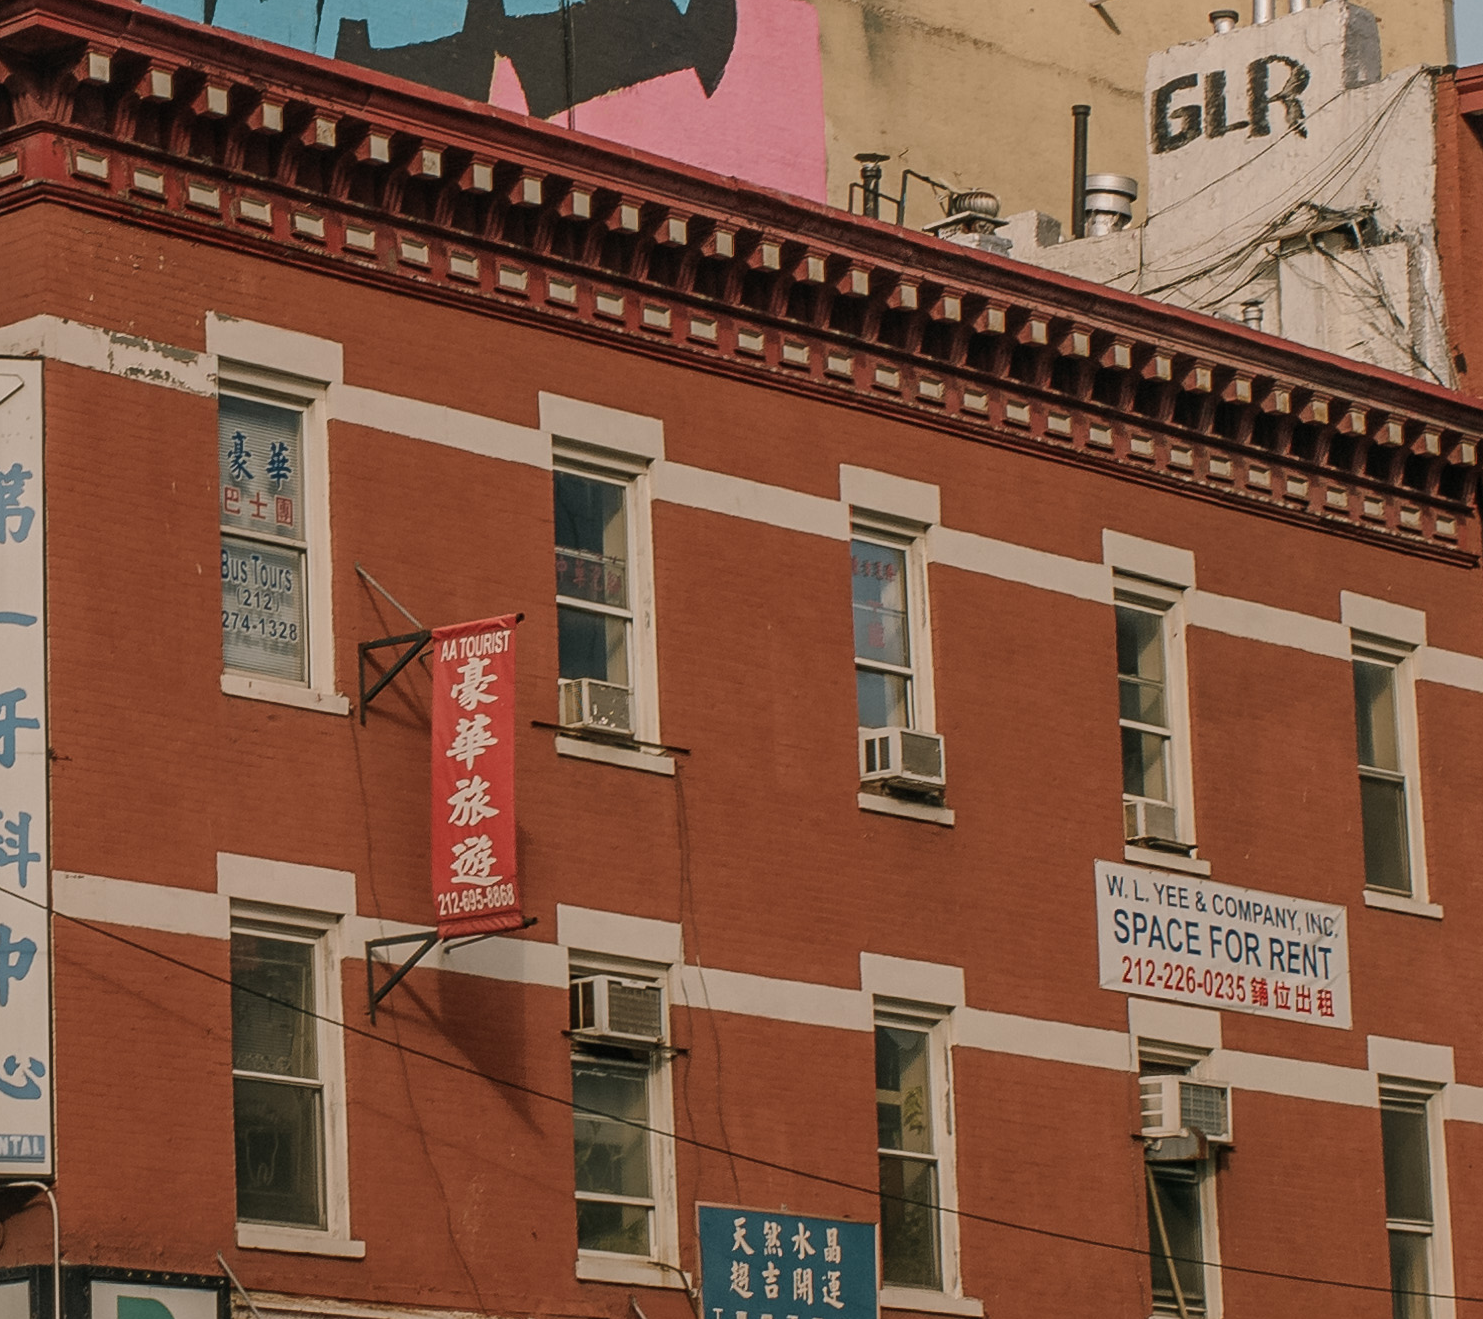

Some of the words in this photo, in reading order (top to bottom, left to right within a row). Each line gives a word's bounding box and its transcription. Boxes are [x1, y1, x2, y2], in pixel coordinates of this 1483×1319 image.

[1152, 54, 1311, 154] GLR
[227, 431, 293, 489] 豪華
[224, 487, 294, 527] 巴士團
[221, 548, 248, 581] Bus
[251, 554, 293, 592] Tours
[236, 589, 281, 614] (212)
[221, 612, 298, 643] 274-1328
[439, 639, 458, 662] AA
[459, 629, 511, 658] TOURIST
[446, 655, 503, 887] 豪華旅遊
[437, 883, 516, 916] 212-695-8868
[1106, 874, 1129, 899] W.
[1133, 879, 1150, 903] L.
[1153, 881, 1191, 910] YEE
[1195, 890, 1208, 913] &
[1211, 893, 1303, 936] COMPANY,
[1305, 911, 1339, 939] INC.
[1114, 908, 1202, 957] SPACE
[1209, 924, 1263, 968] FOR
[1269, 936, 1333, 981] RENT
[1121, 955, 1247, 1003] 212-226-0235
[731, 1216, 842, 1264] 天然水晶
